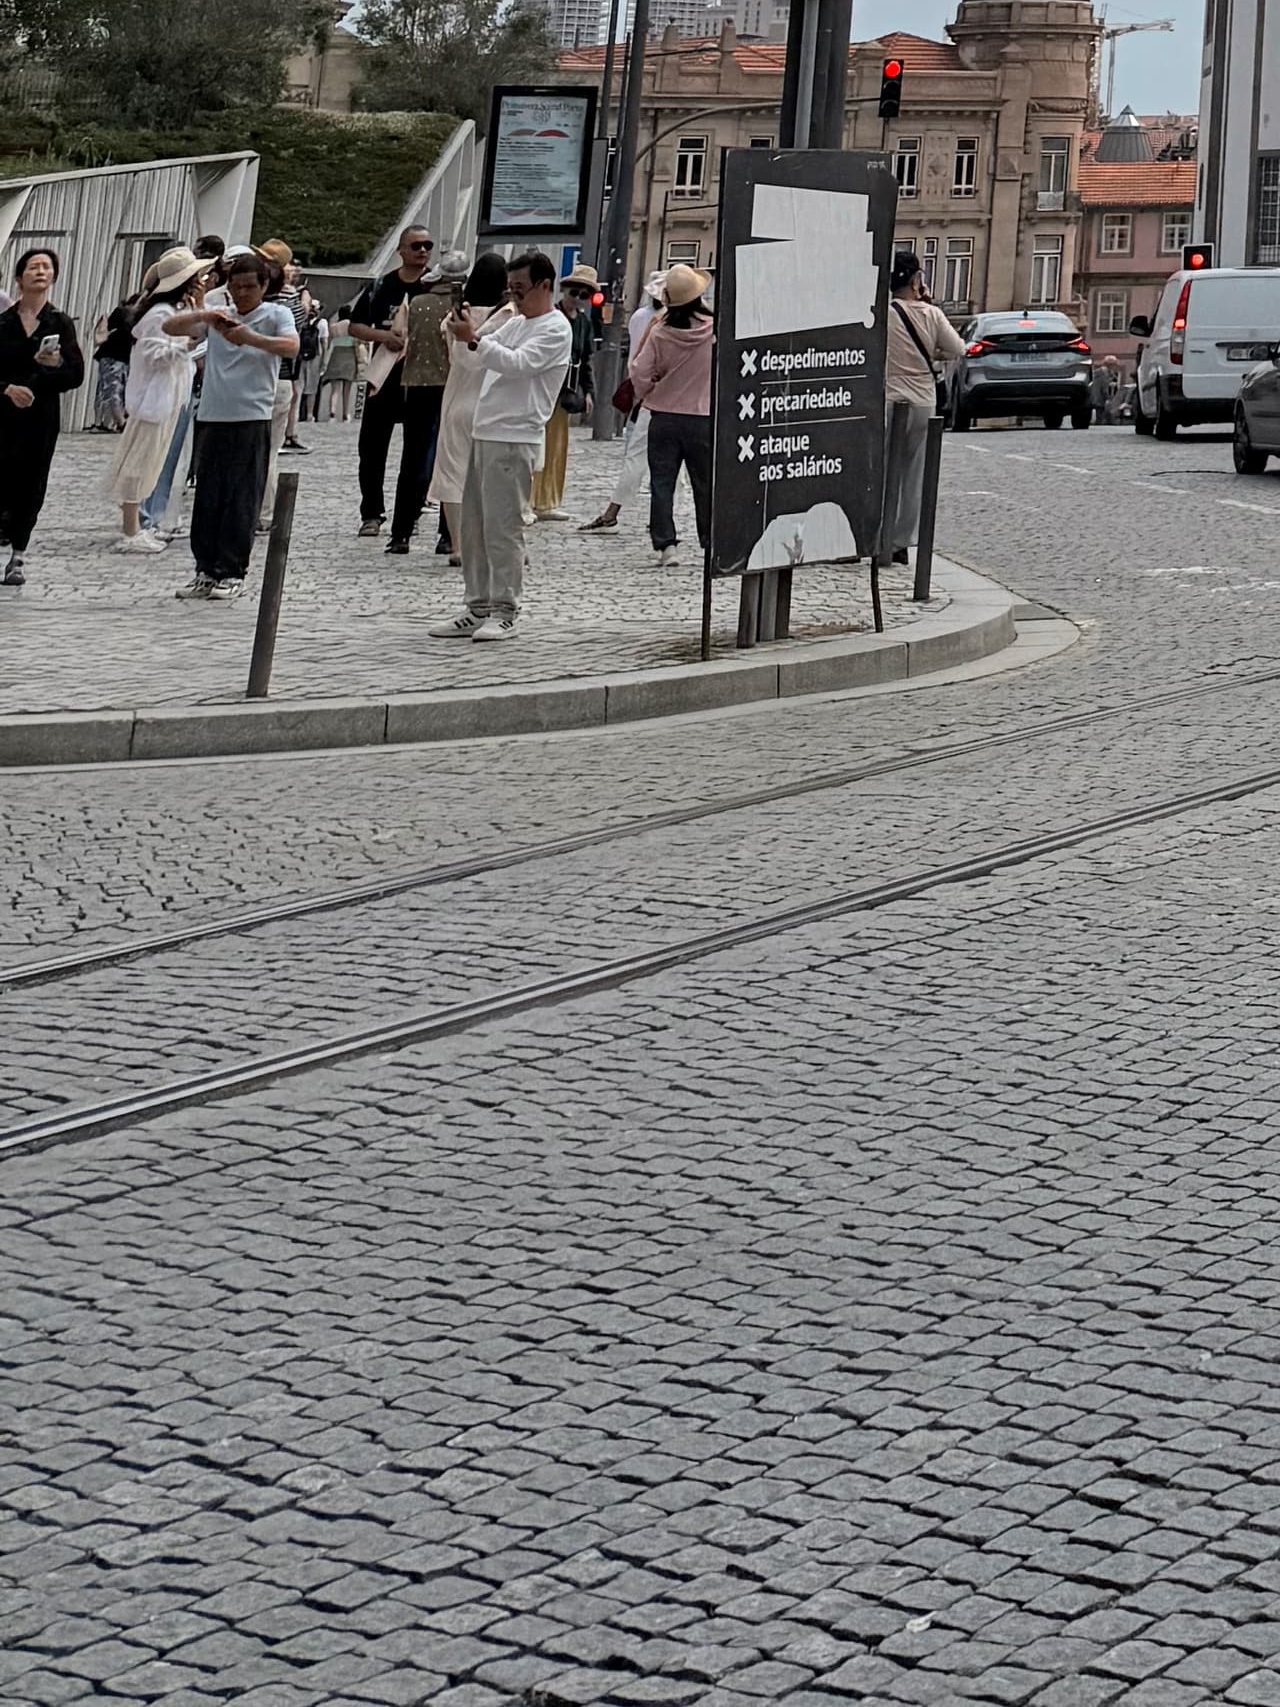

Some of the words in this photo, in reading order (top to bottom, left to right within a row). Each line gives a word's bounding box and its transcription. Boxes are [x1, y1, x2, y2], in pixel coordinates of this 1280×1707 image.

[761, 348, 865, 375] despedimentos
[761, 386, 851, 419] precariedade
[759, 434, 810, 458] ataque
[759, 462, 783, 482] aos
[786, 454, 842, 479] salários
